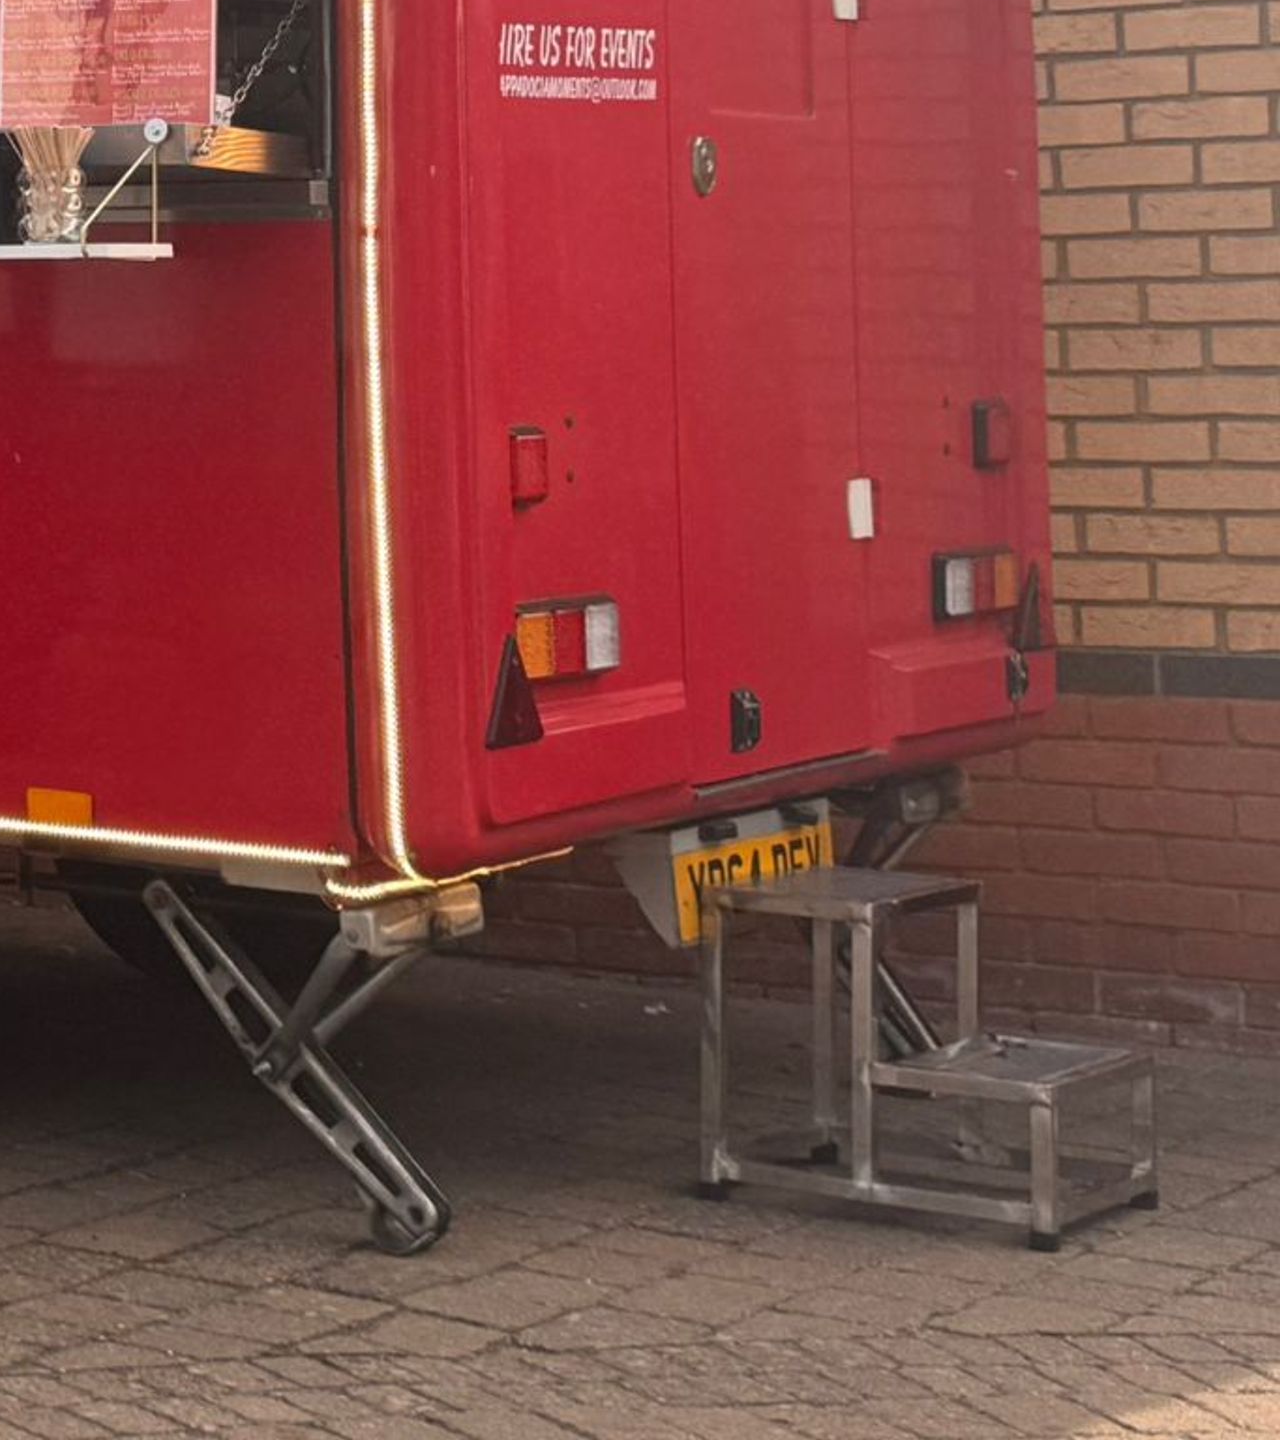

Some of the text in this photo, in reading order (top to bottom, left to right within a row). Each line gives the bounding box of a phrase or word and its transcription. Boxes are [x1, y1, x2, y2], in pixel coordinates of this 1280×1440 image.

[539, 24, 562, 67] US
[565, 25, 597, 71] FOR
[600, 27, 656, 70] EVENTS
